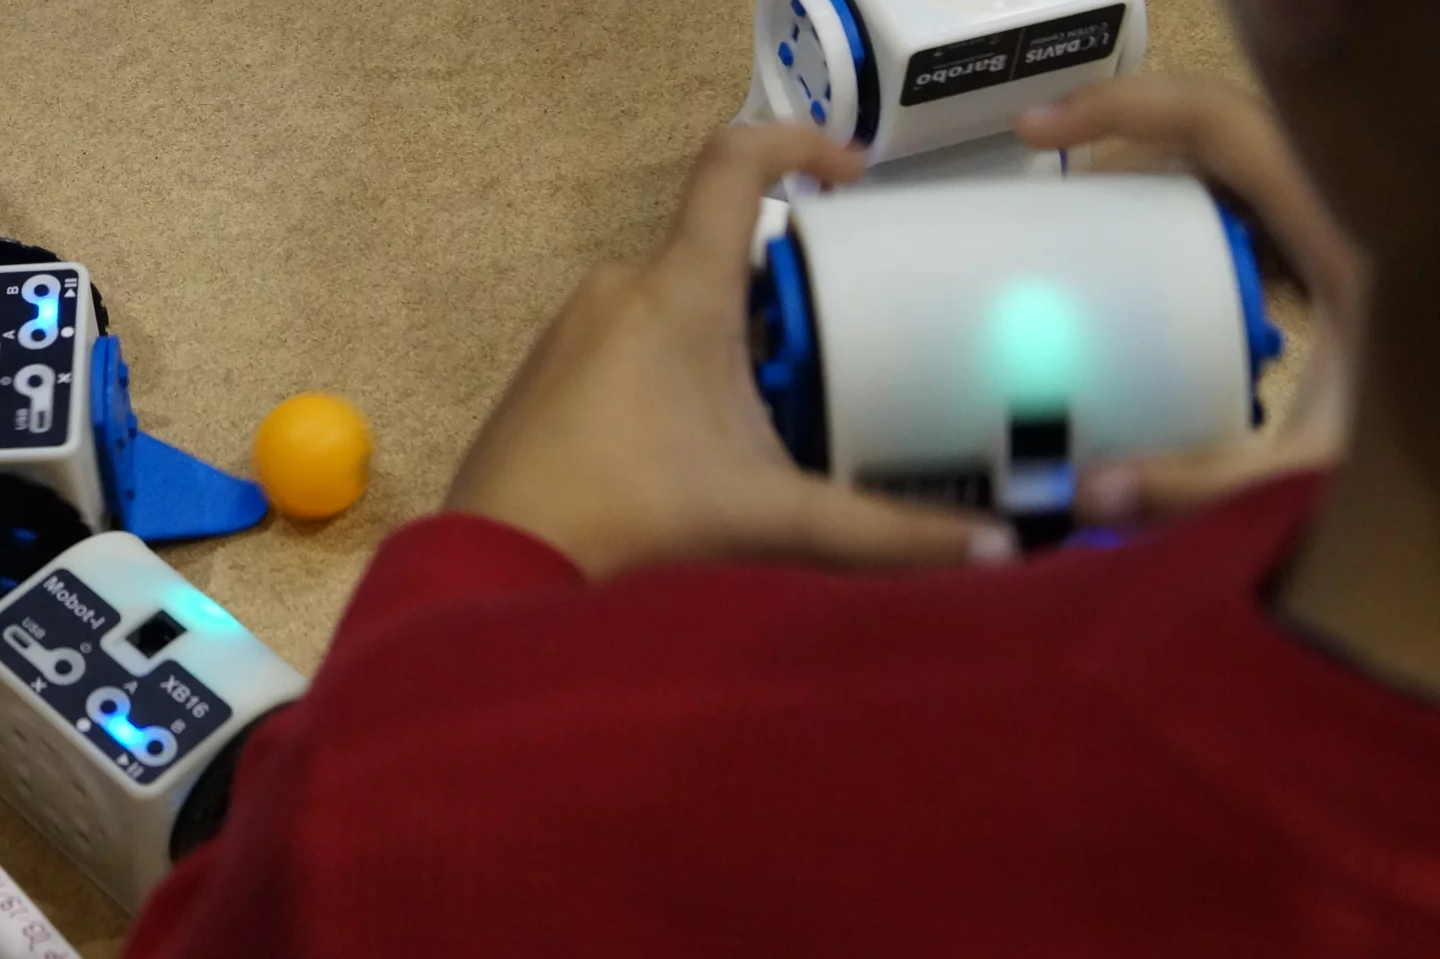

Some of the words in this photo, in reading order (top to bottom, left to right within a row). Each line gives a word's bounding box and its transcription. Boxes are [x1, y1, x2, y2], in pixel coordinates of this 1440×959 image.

[916, 54, 1008, 85] Barobo
[15, 408, 29, 430] USB
[21, 617, 47, 640] USB
[160, 674, 210, 719] XB16
